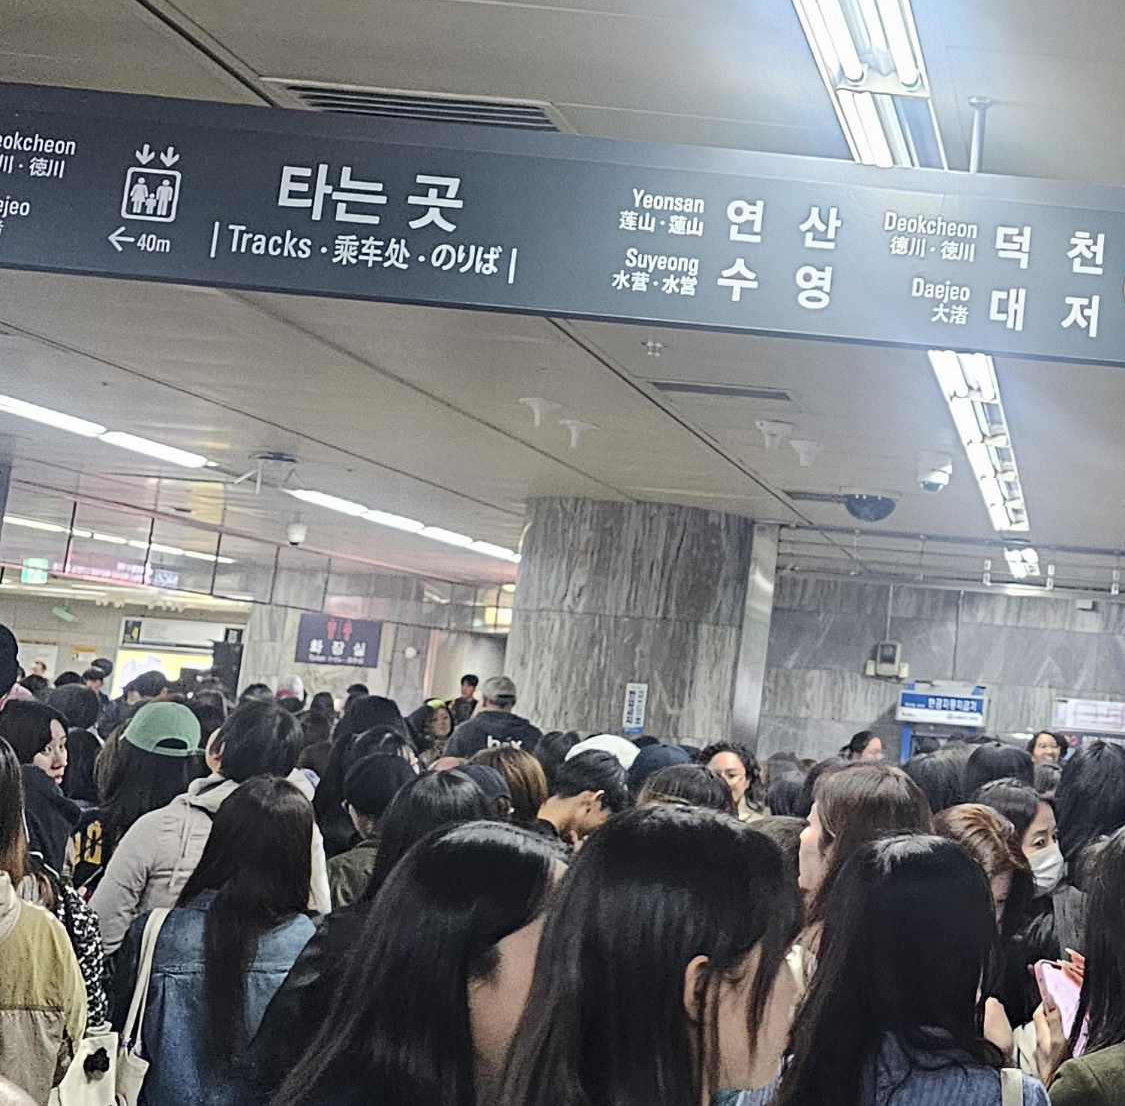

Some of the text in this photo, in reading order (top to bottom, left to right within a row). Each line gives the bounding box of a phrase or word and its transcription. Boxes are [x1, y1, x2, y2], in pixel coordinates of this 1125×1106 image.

[278, 164, 464, 232] 타는 곳
[633, 189, 705, 214] Yeonsan
[884, 211, 978, 239] Deokcheon
[136, 234, 171, 253] 40m
[228, 224, 503, 275] Tracks 乘车处 のりば
[625, 248, 700, 277] Suyeong
[911, 277, 971, 304] Daejeo
[930, 302, 969, 326] 大渚
